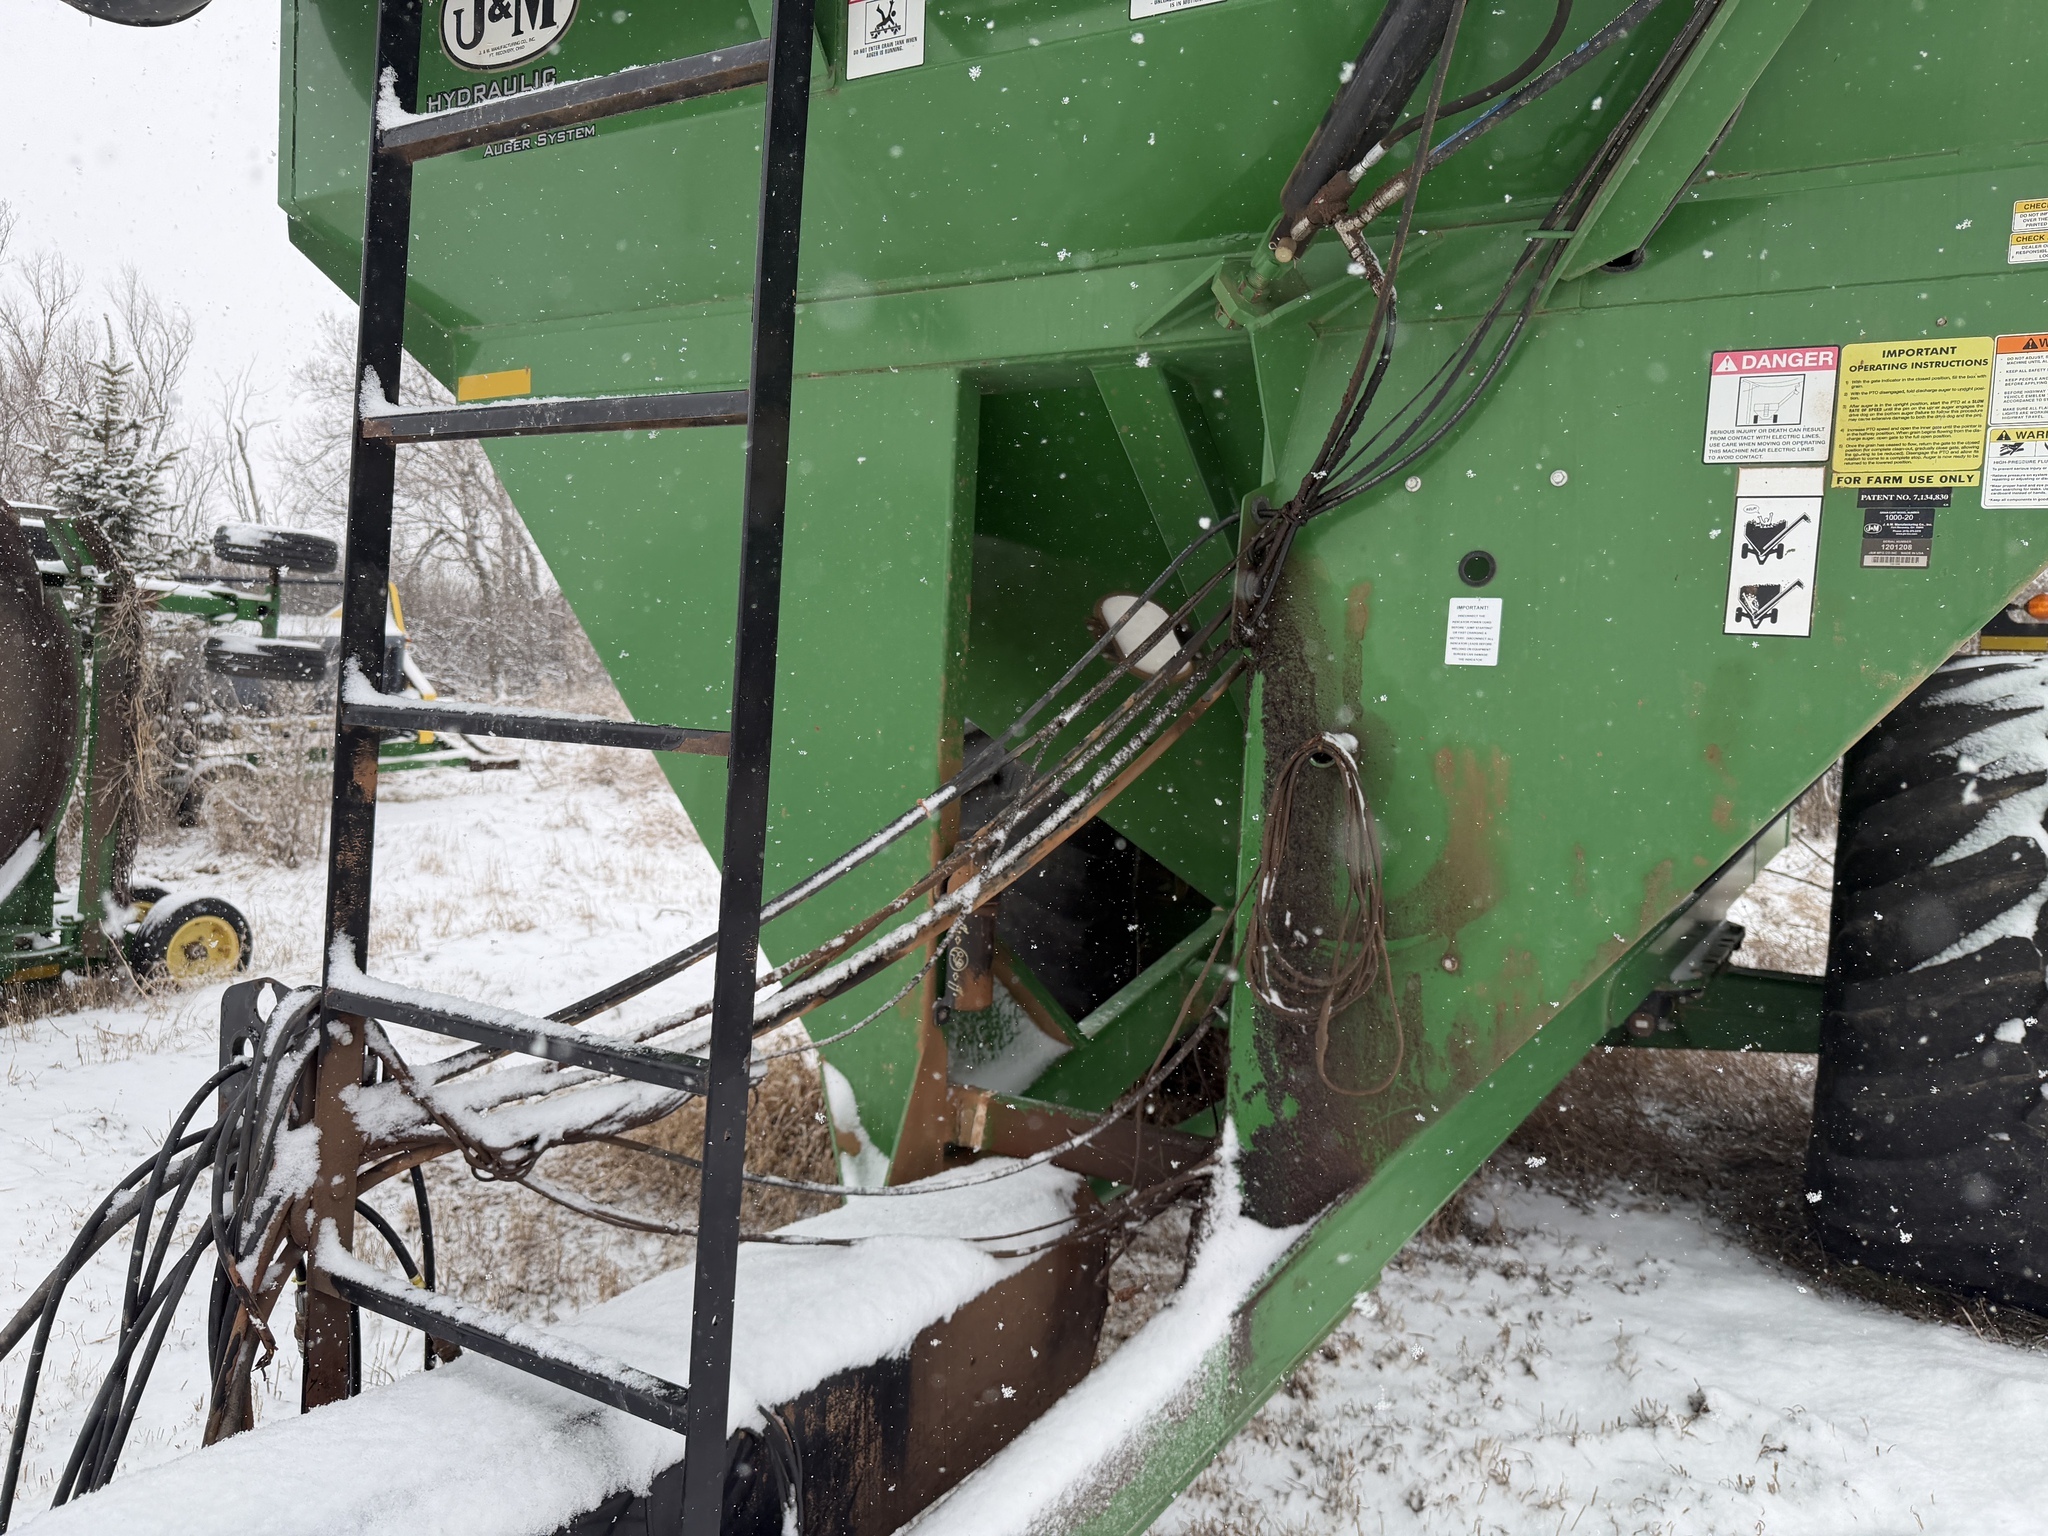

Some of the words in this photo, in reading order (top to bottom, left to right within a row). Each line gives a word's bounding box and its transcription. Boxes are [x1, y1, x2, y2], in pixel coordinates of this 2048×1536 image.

[427, 68, 557, 113] HYDRAULIC
[483, 138, 532, 158] AUGER
[537, 125, 596, 147] SYSTEM
[1882, 346, 1957, 358] IMPORTANT
[1742, 351, 1834, 370] DANGER
[1849, 362, 1908, 372] OPERATING
[1911, 358, 1989, 369] INSTRUCTIONS
[1836, 476, 1861, 484] FOR
[1866, 475, 1903, 484] FARM
[1908, 475, 1934, 484] USE
[1939, 474, 1975, 483] ONLY
